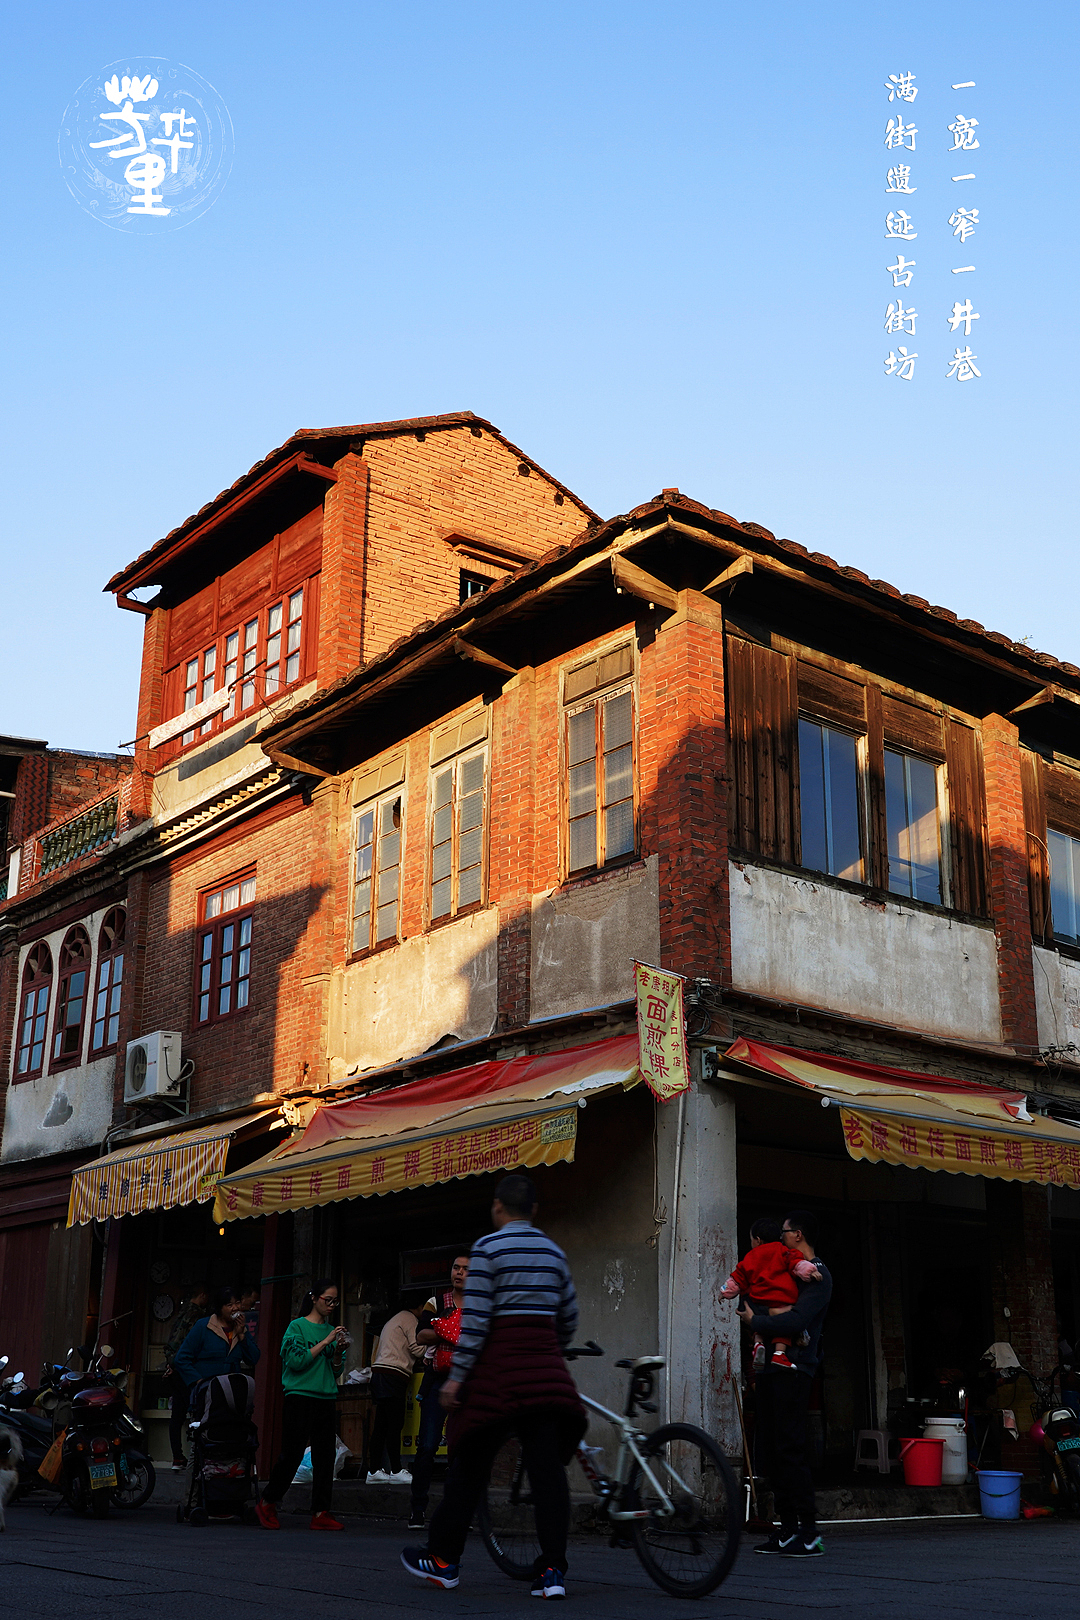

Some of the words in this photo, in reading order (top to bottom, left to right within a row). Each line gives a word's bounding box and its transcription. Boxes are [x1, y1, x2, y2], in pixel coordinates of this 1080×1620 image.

[644, 994, 670, 1078] 面煎粿
[843, 1116, 1025, 1171] 老康祖传面煎粿
[227, 1150, 421, 1211] 老康祖传面煎粿
